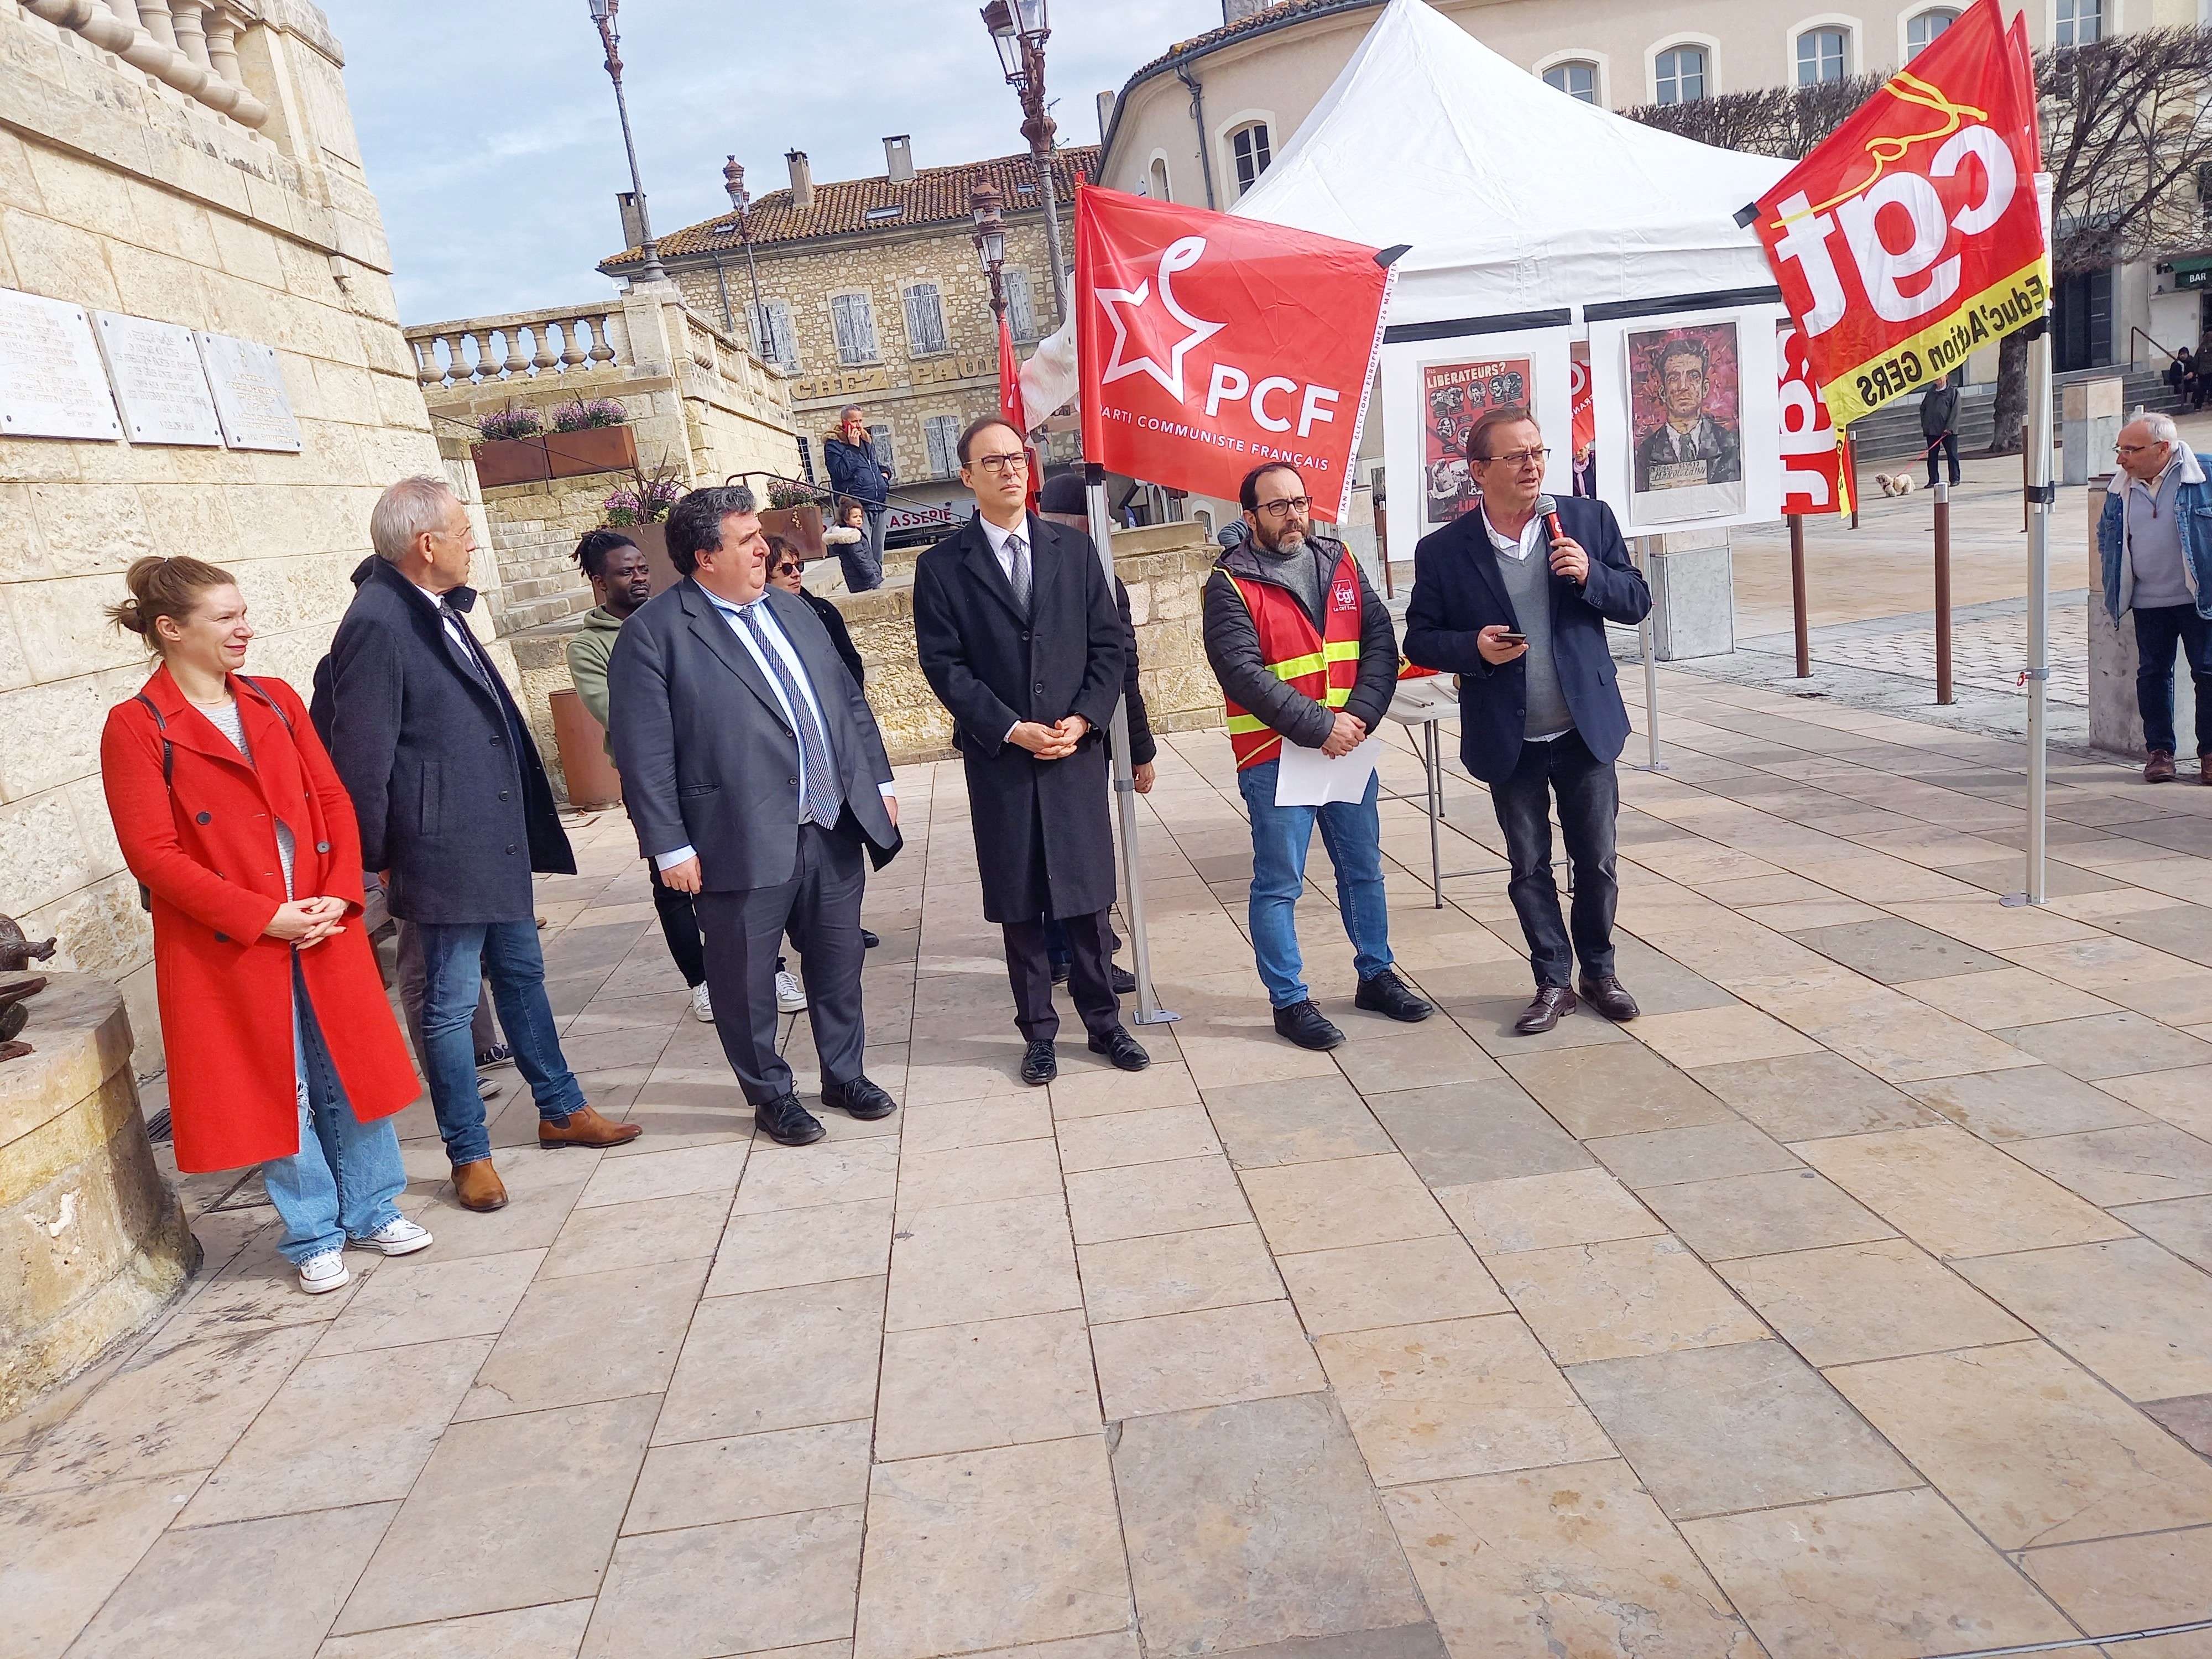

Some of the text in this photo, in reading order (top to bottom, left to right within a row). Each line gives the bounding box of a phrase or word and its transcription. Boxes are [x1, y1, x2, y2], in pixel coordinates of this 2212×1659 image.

[2189, 273, 2206, 283] BAR
[1381, 310, 1387, 320] 26
[791, 370, 889, 399] CHEZ
[1204, 363, 1340, 438] PCF
[1137, 415, 1245, 452] COMMUNISTE
[1250, 443, 1329, 471] FRANÇAIS
[886, 507, 952, 529] ASSERIE
[1335, 588, 1355, 604] cgt
